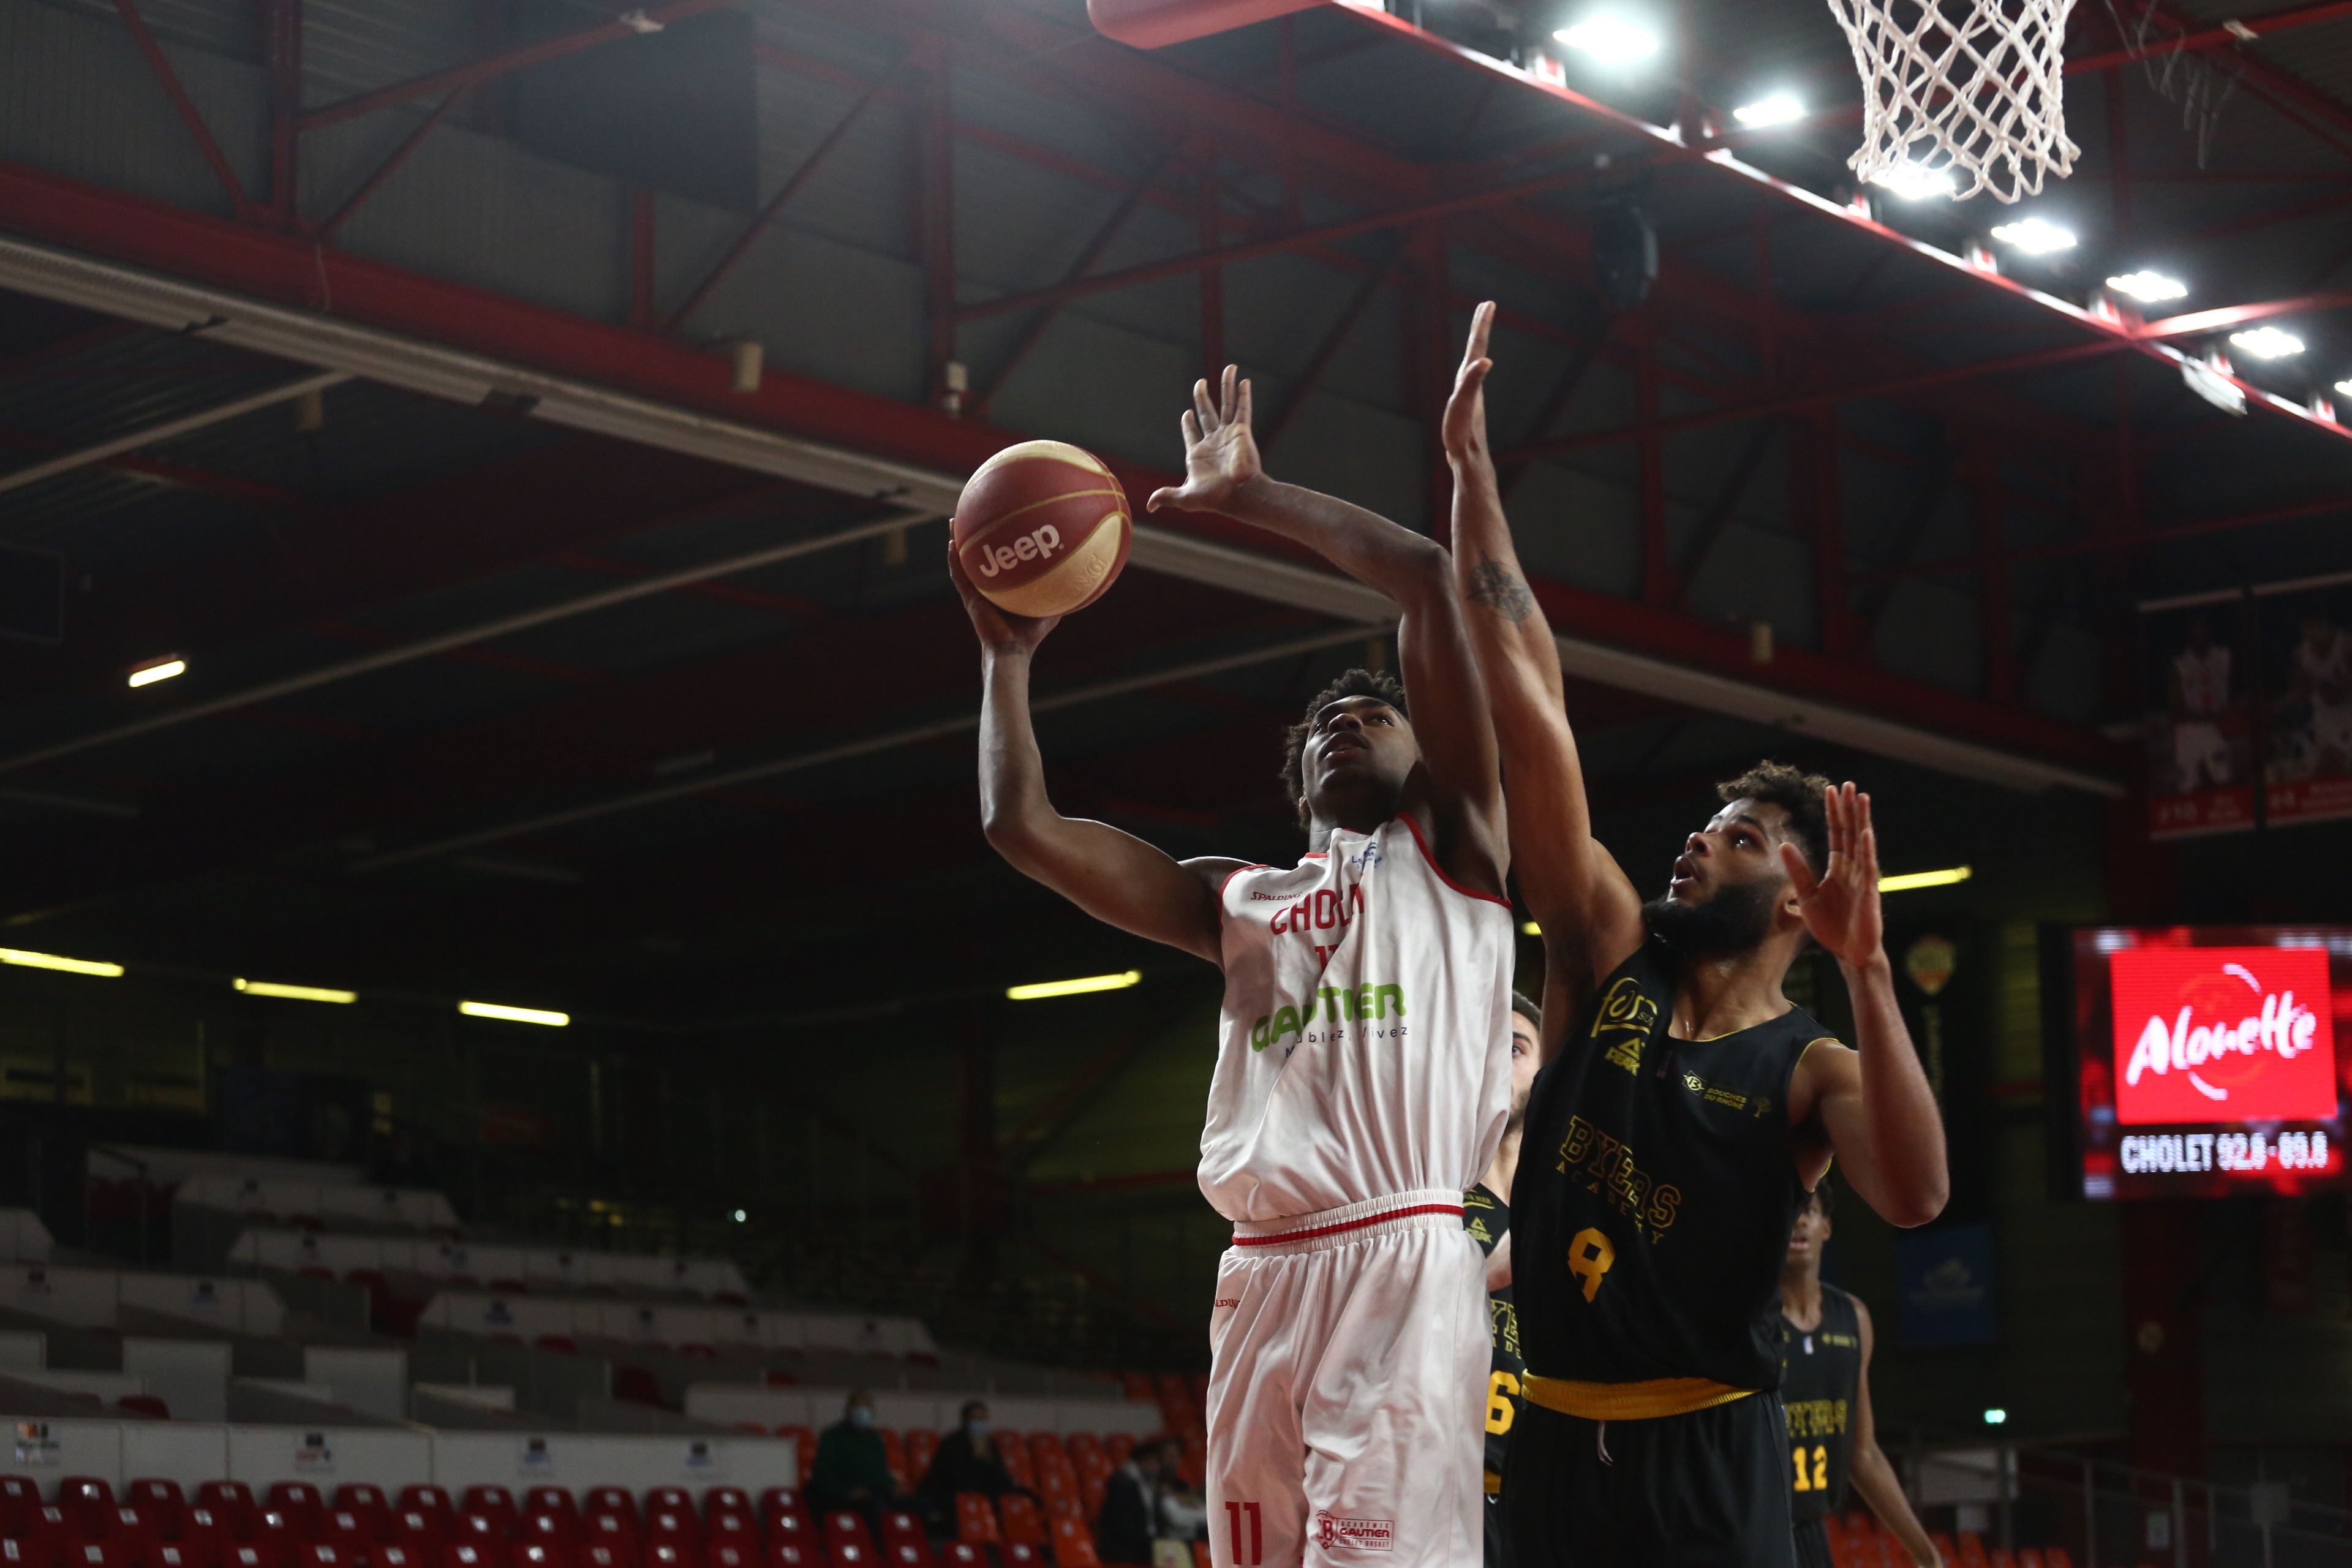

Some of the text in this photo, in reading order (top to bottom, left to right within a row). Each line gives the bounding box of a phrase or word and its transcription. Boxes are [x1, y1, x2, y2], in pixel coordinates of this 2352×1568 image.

[980, 524, 1060, 578] Jeep
[1250, 891, 1303, 901] SPALDING
[1604, 1046, 1641, 1077] PEAK
[2125, 990, 2316, 1086] Alouette
[1706, 1088, 1748, 1104] BOUCHES
[1559, 1114, 1683, 1229] BYERS
[2120, 1134, 2215, 1173] CHOLET
[1567, 1226, 1616, 1304] 9
[1485, 1370, 1521, 1436] 6
[1792, 1444, 1828, 1493] 12
[1225, 1501, 1262, 1566] 11
[1340, 1527, 1390, 1538] GAUTIER
